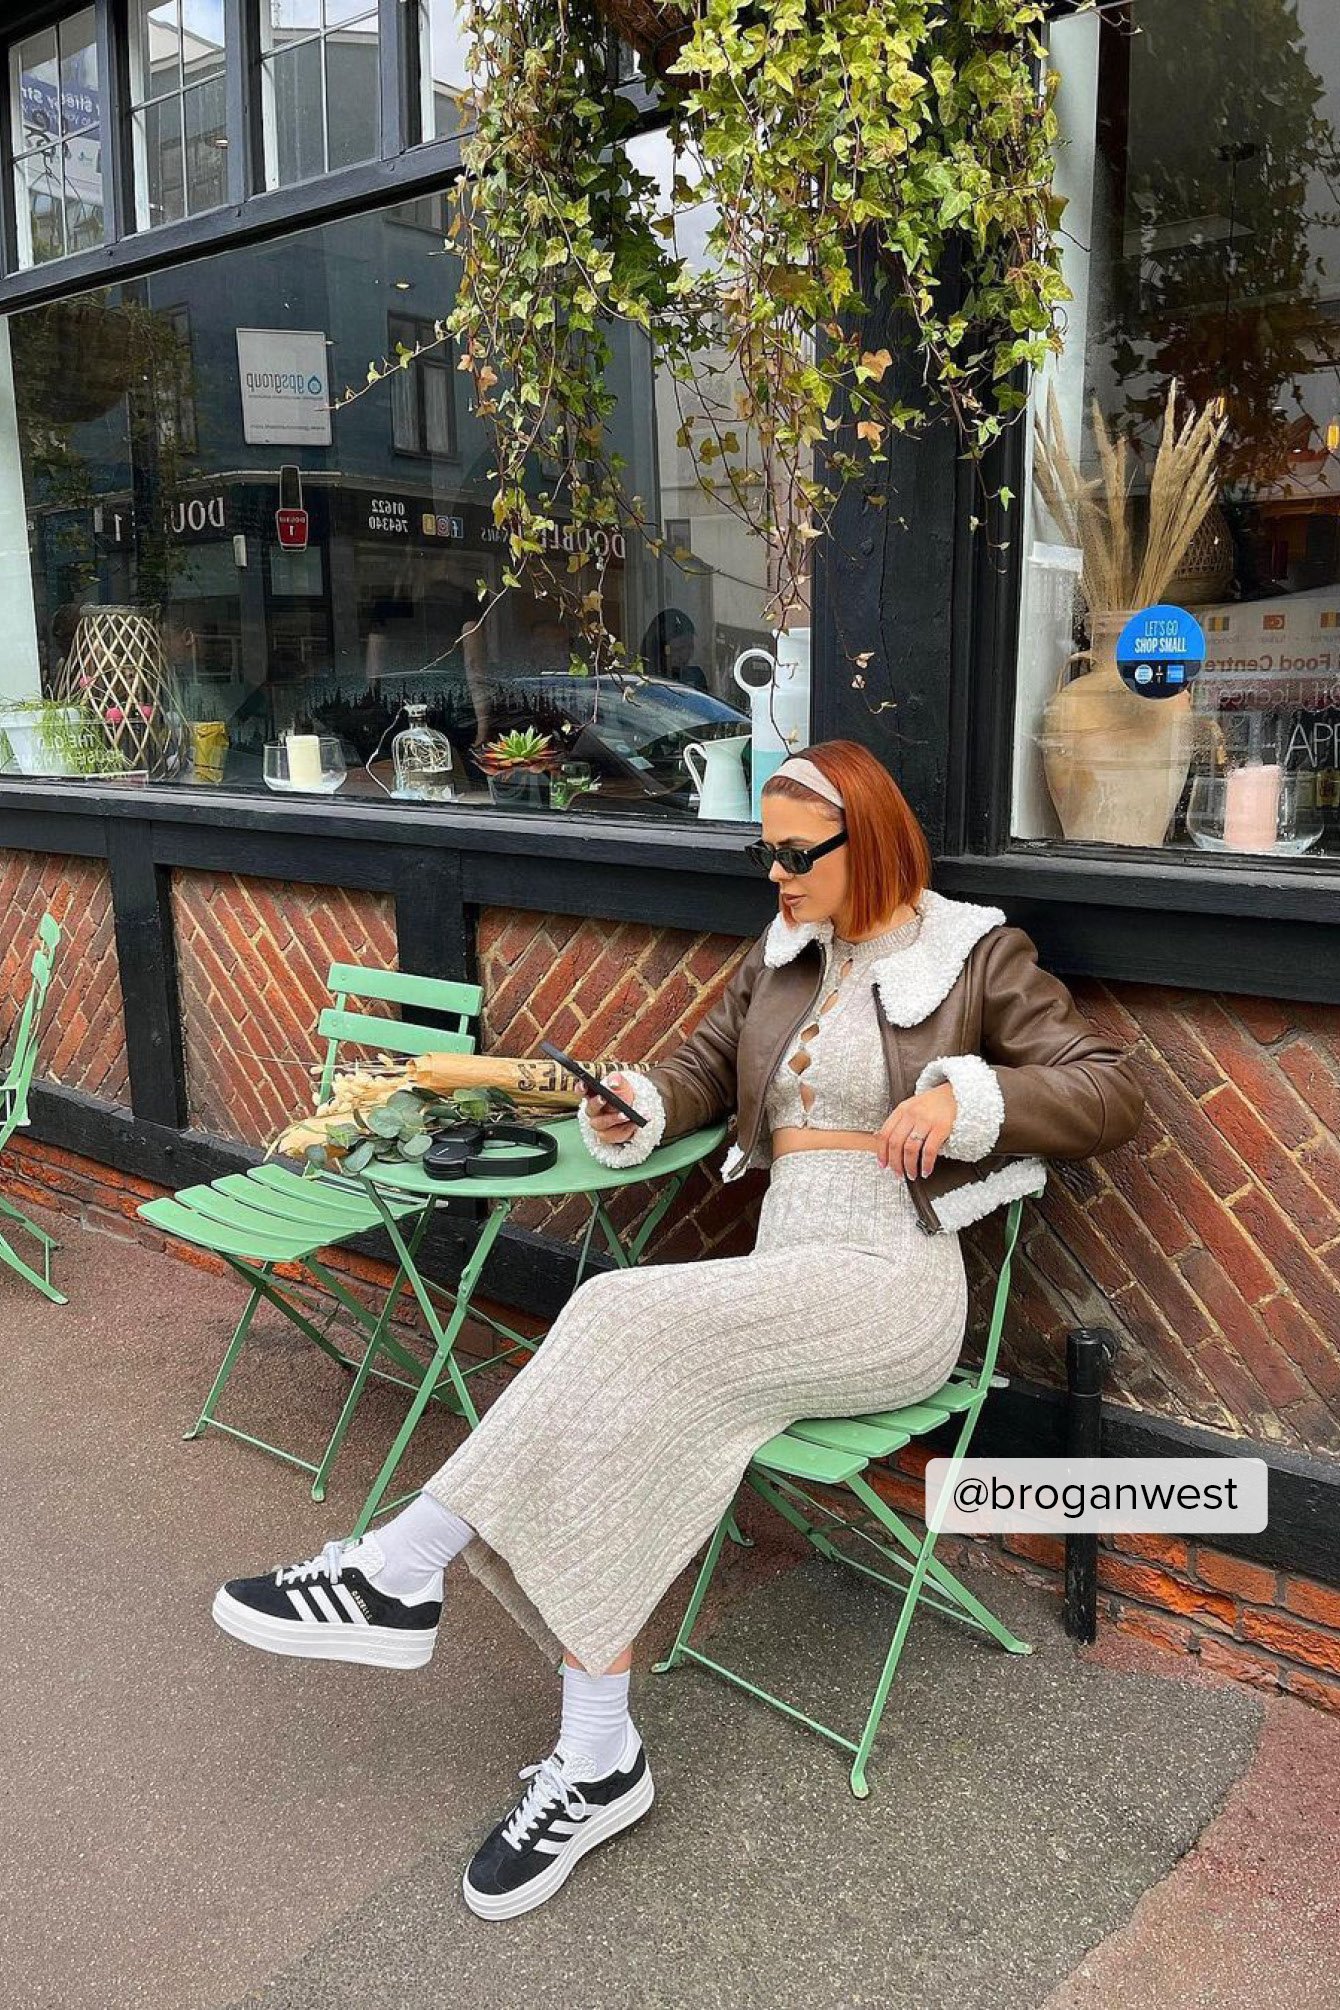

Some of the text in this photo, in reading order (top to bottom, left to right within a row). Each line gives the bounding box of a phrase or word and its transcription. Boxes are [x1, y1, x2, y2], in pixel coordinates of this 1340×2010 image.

[1145, 619, 1179, 636] LET'S GO
[1134, 637, 1187, 653] SHOP SMALL
